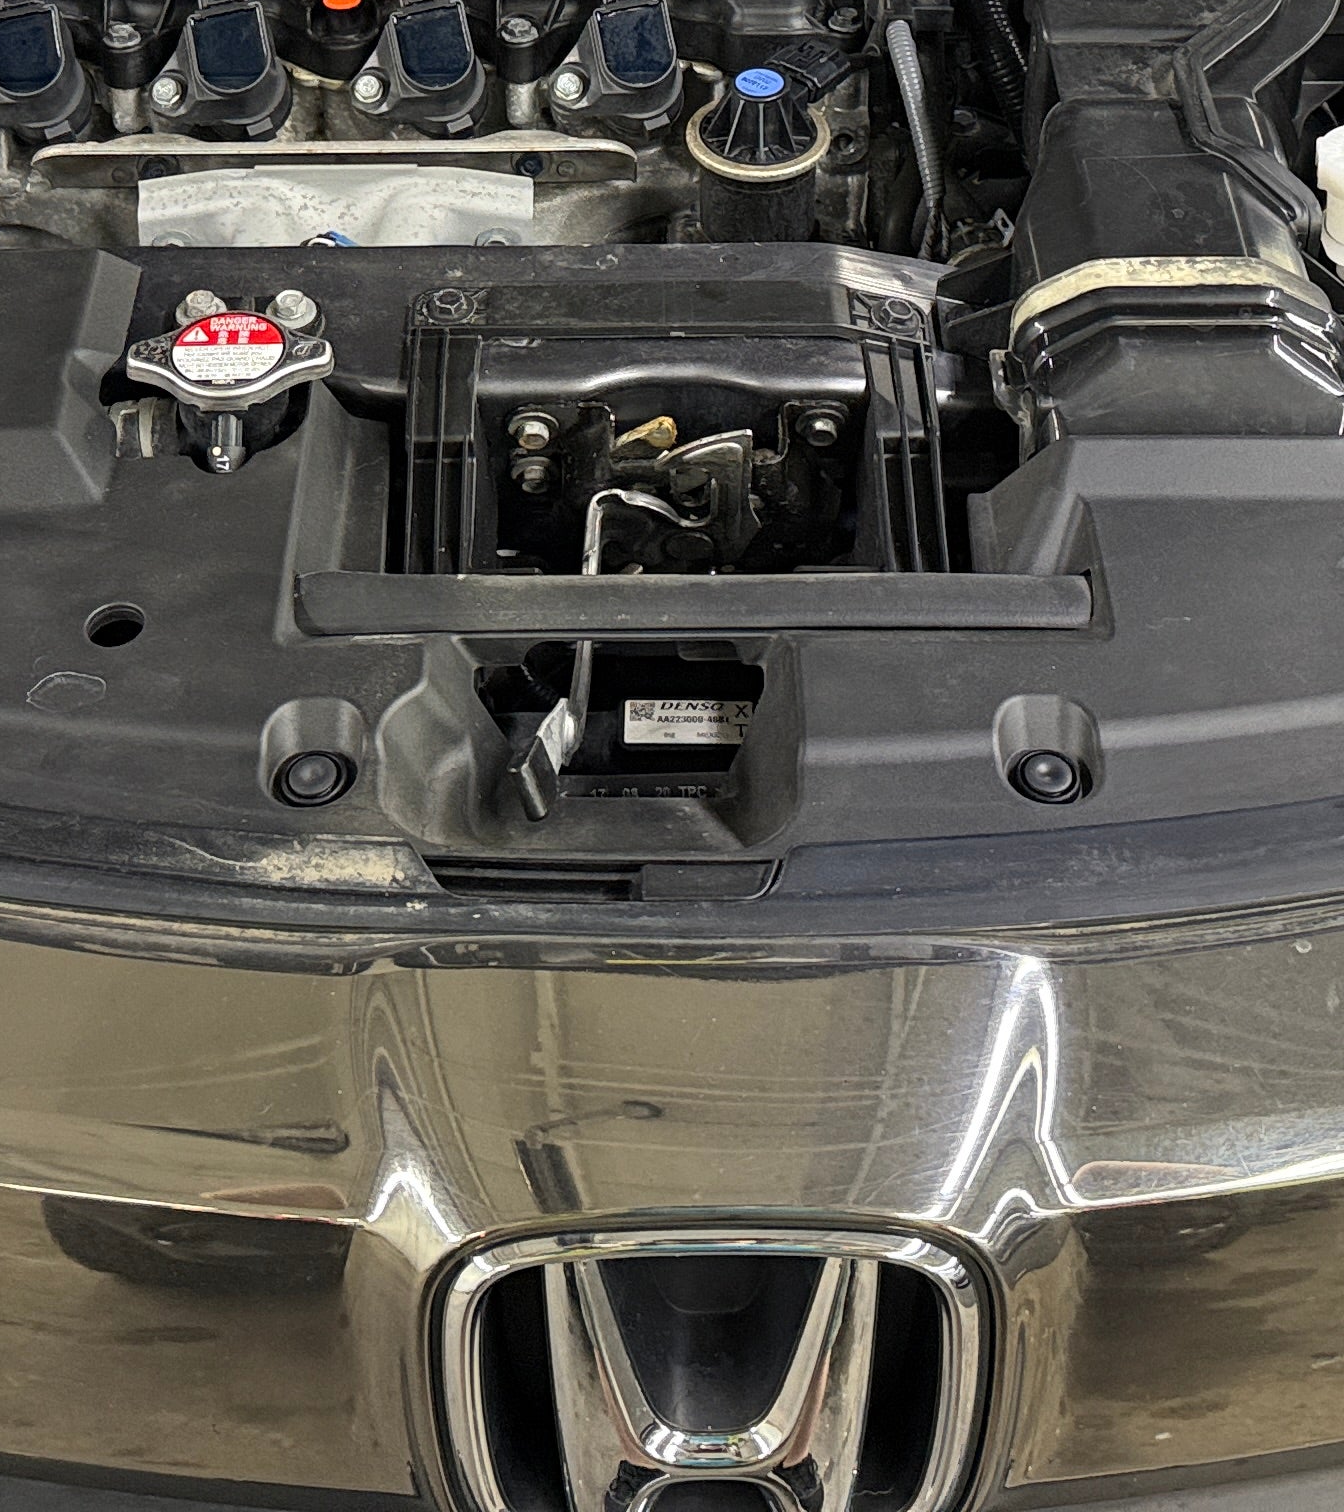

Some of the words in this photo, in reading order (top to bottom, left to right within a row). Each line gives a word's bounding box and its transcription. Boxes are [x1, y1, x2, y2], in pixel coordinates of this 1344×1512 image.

[210, 316, 257, 325] DANGER
[209, 322, 268, 332] WARNUNG
[216, 455, 230, 471] 17
[660, 701, 725, 711] DENSO
